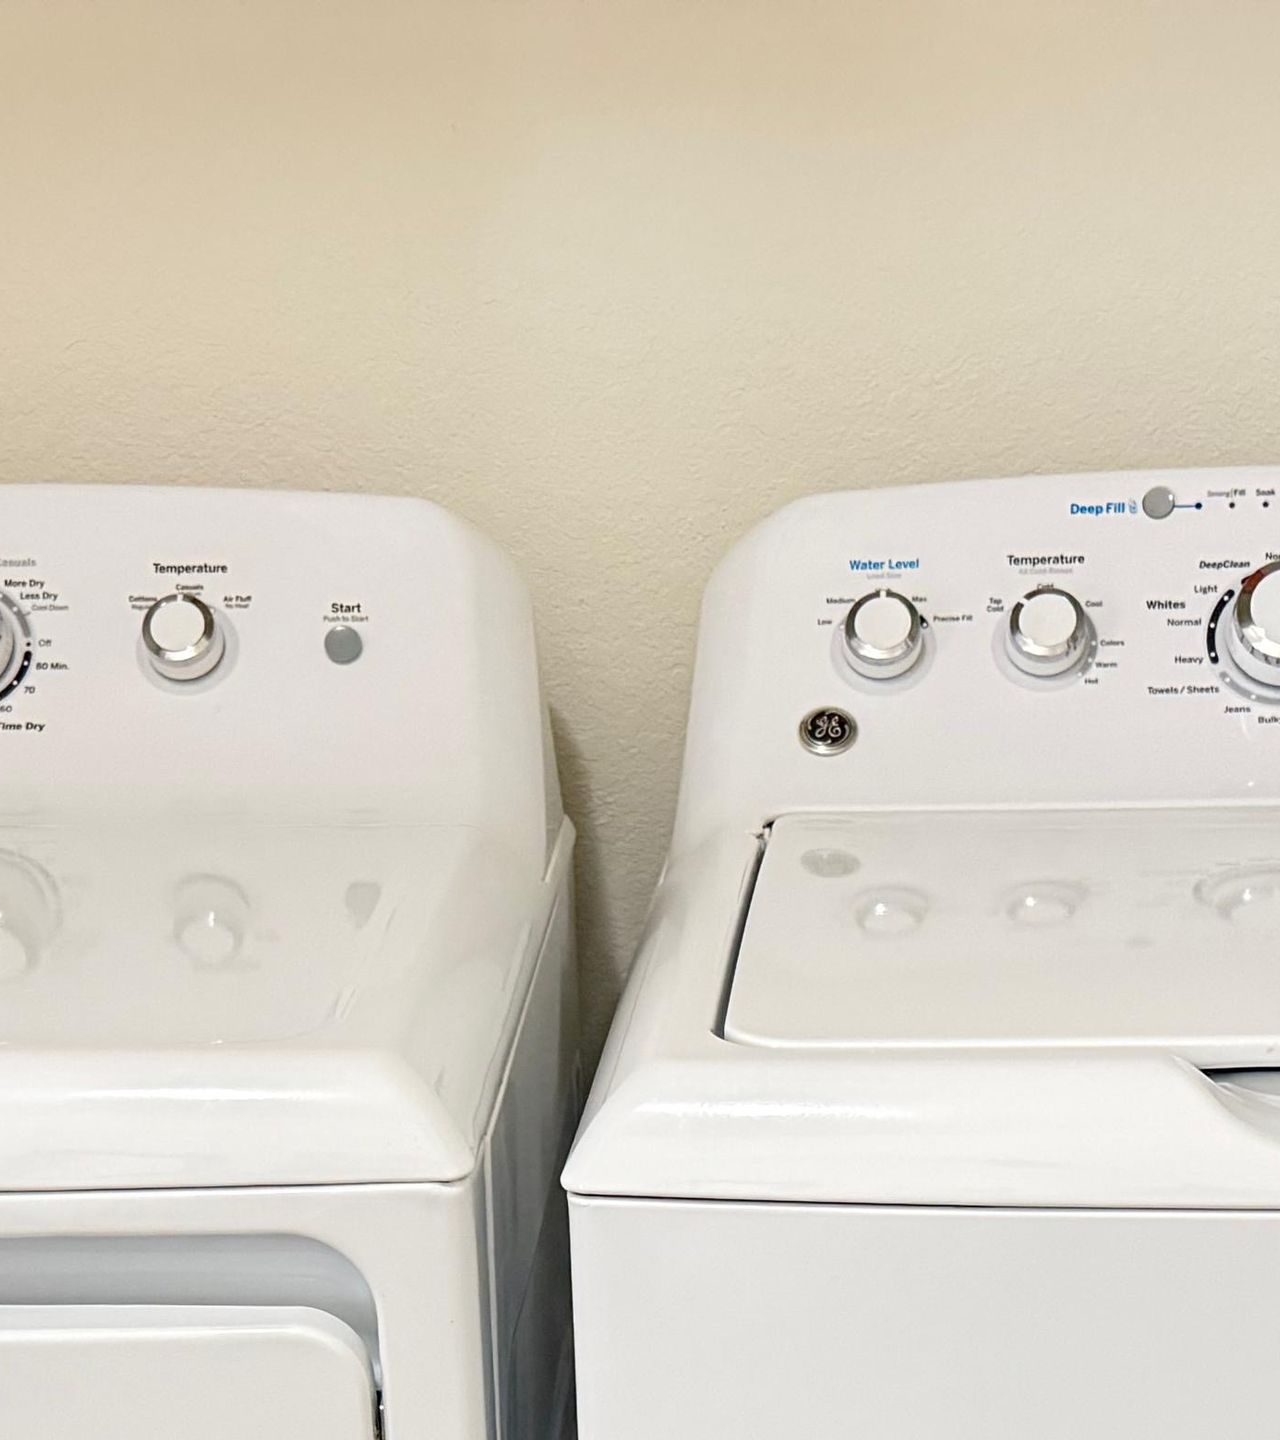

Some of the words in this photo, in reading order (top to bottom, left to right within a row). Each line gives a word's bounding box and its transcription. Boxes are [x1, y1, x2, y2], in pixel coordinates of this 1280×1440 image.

[1070, 504, 1103, 517] Deep
[1106, 502, 1125, 513] Fill
[849, 559, 885, 570] Water
[888, 558, 919, 569] Level
[1007, 554, 1085, 567] Temperature
[1199, 560, 1250, 570] DeepClean
[153, 563, 228, 575] Temperature
[4, 580, 25, 588] More
[27, 580, 45, 590] Dry
[1194, 585, 1218, 595] Light
[20, 592, 38, 600] Less
[40, 592, 58, 602] Dry
[331, 603, 361, 613] Start
[1147, 600, 1186, 609] Whites
[1167, 618, 1202, 626] Normal
[1175, 656, 1203, 665] Heavy
[24, 686, 36, 694] 70
[1148, 686, 1178, 695] Towels
[1187, 686, 1219, 694] Sheets
[0, 705, 12, 713] 60
[1224, 705, 1251, 714] Jeans
[25, 722, 45, 733] Dry
